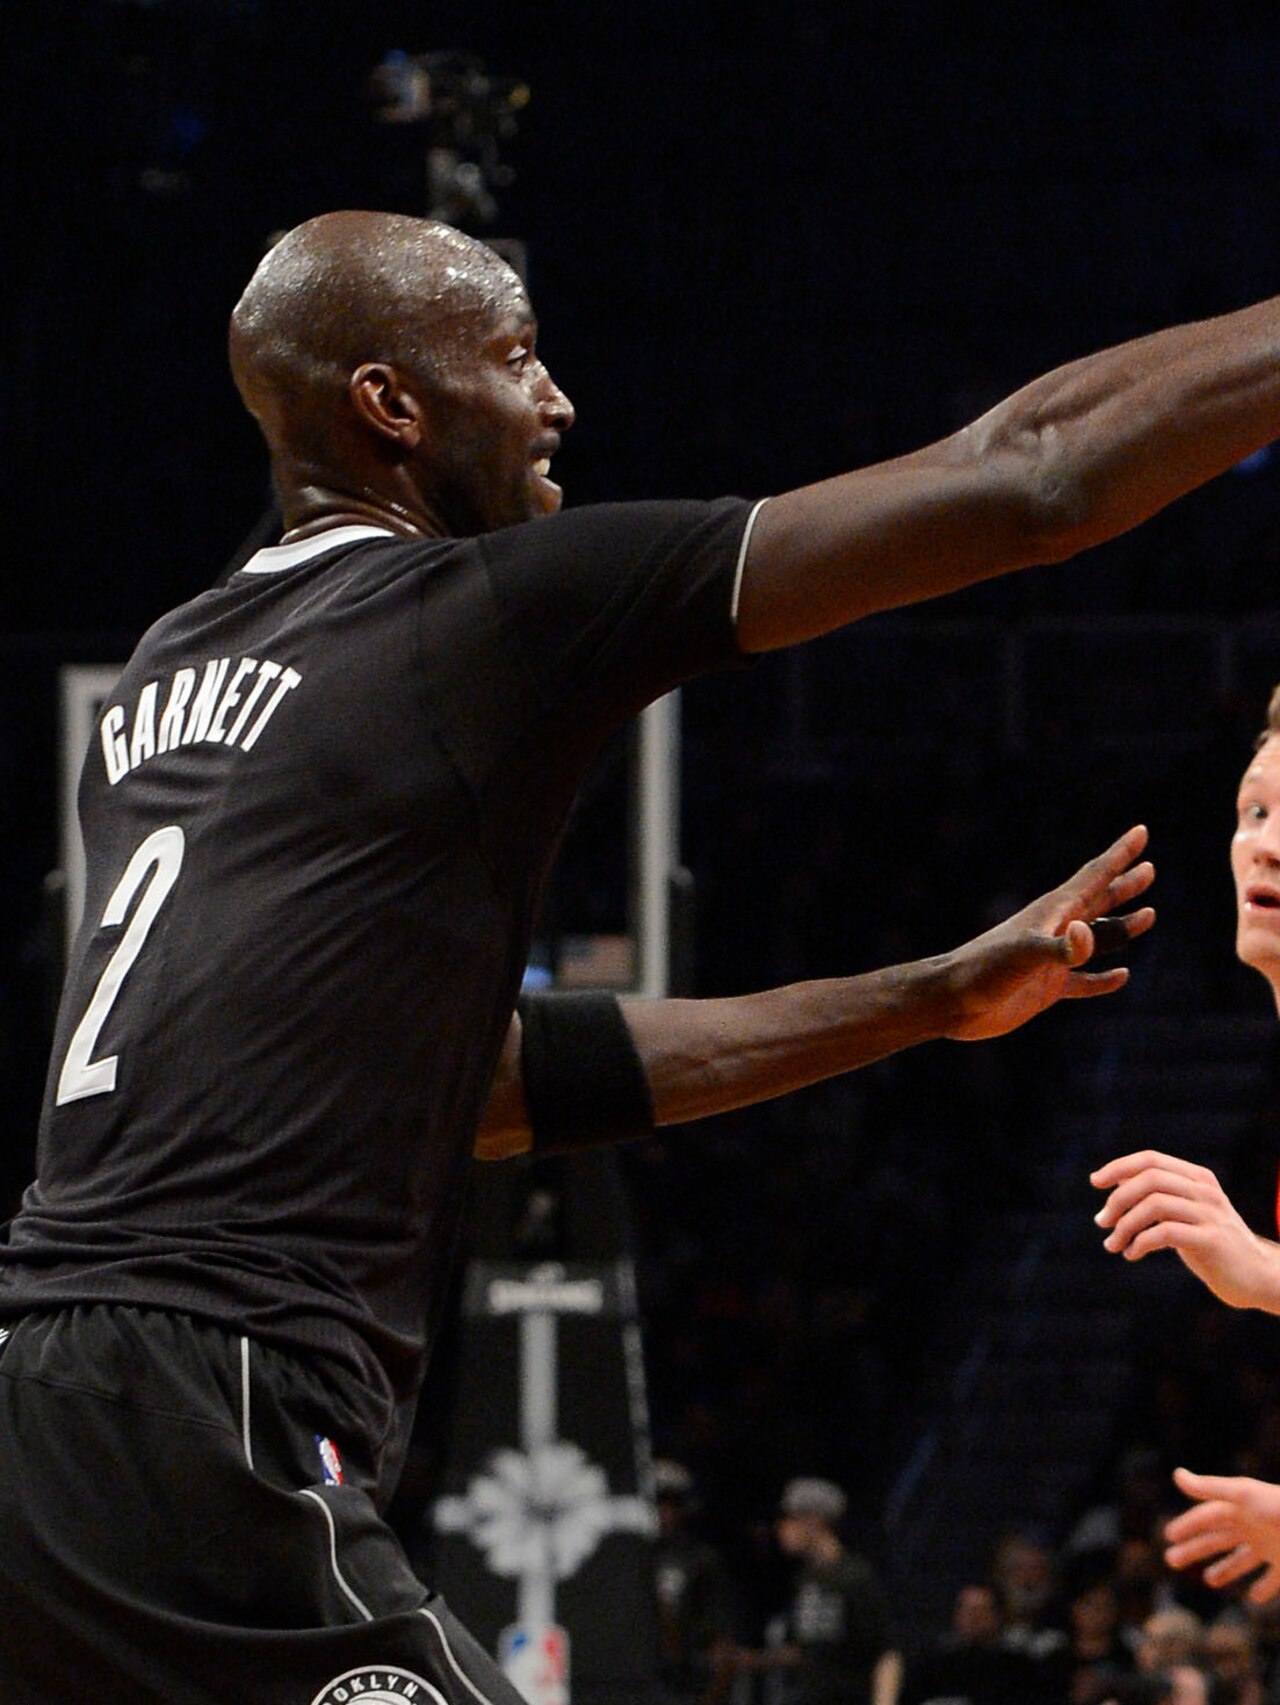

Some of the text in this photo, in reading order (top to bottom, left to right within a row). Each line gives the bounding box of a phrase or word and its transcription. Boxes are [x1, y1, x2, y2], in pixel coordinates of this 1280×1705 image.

[101, 657, 303, 786] GARNETT
[56, 825, 185, 1106] 2
[320, 1674, 419, 1705] OKLYN
